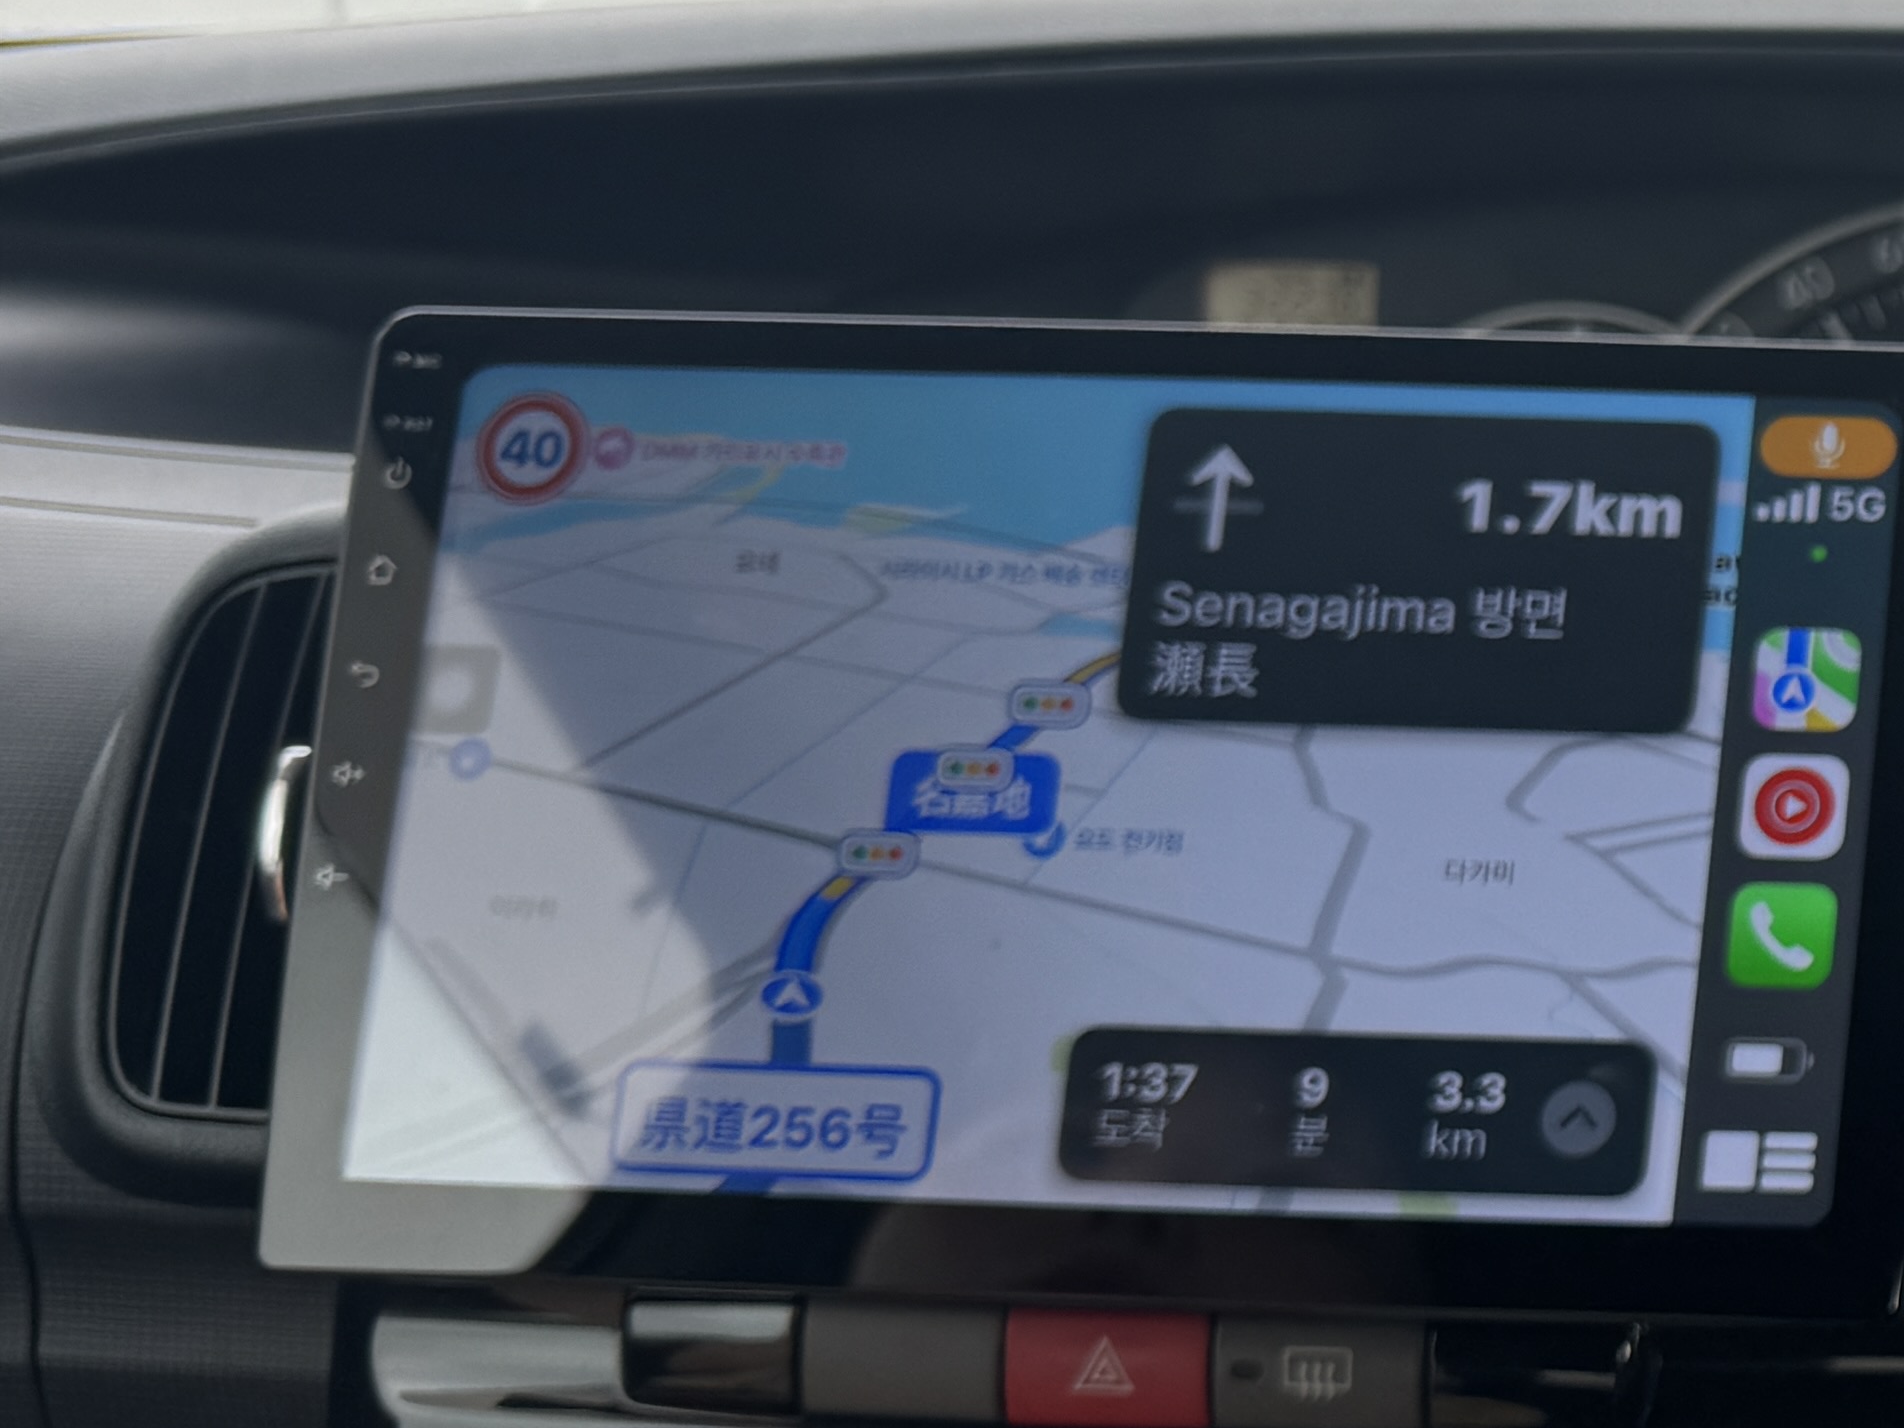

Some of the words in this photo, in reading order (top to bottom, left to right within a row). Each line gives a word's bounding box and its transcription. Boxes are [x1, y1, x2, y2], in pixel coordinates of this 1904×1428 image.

[499, 427, 564, 469] 40
[1458, 479, 1682, 540] 1.7km
[1829, 486, 1887, 522] 5G
[1158, 579, 1456, 640] Senagajima
[1472, 586, 1568, 640] 방면
[1098, 1060, 1199, 1103] 1:37
[1296, 1068, 1331, 1109] 9
[1430, 1071, 1508, 1116] 3.3
[640, 1097, 908, 1161] 県道256号
[1091, 1113, 1169, 1151] 도착
[1424, 1121, 1487, 1161] km
